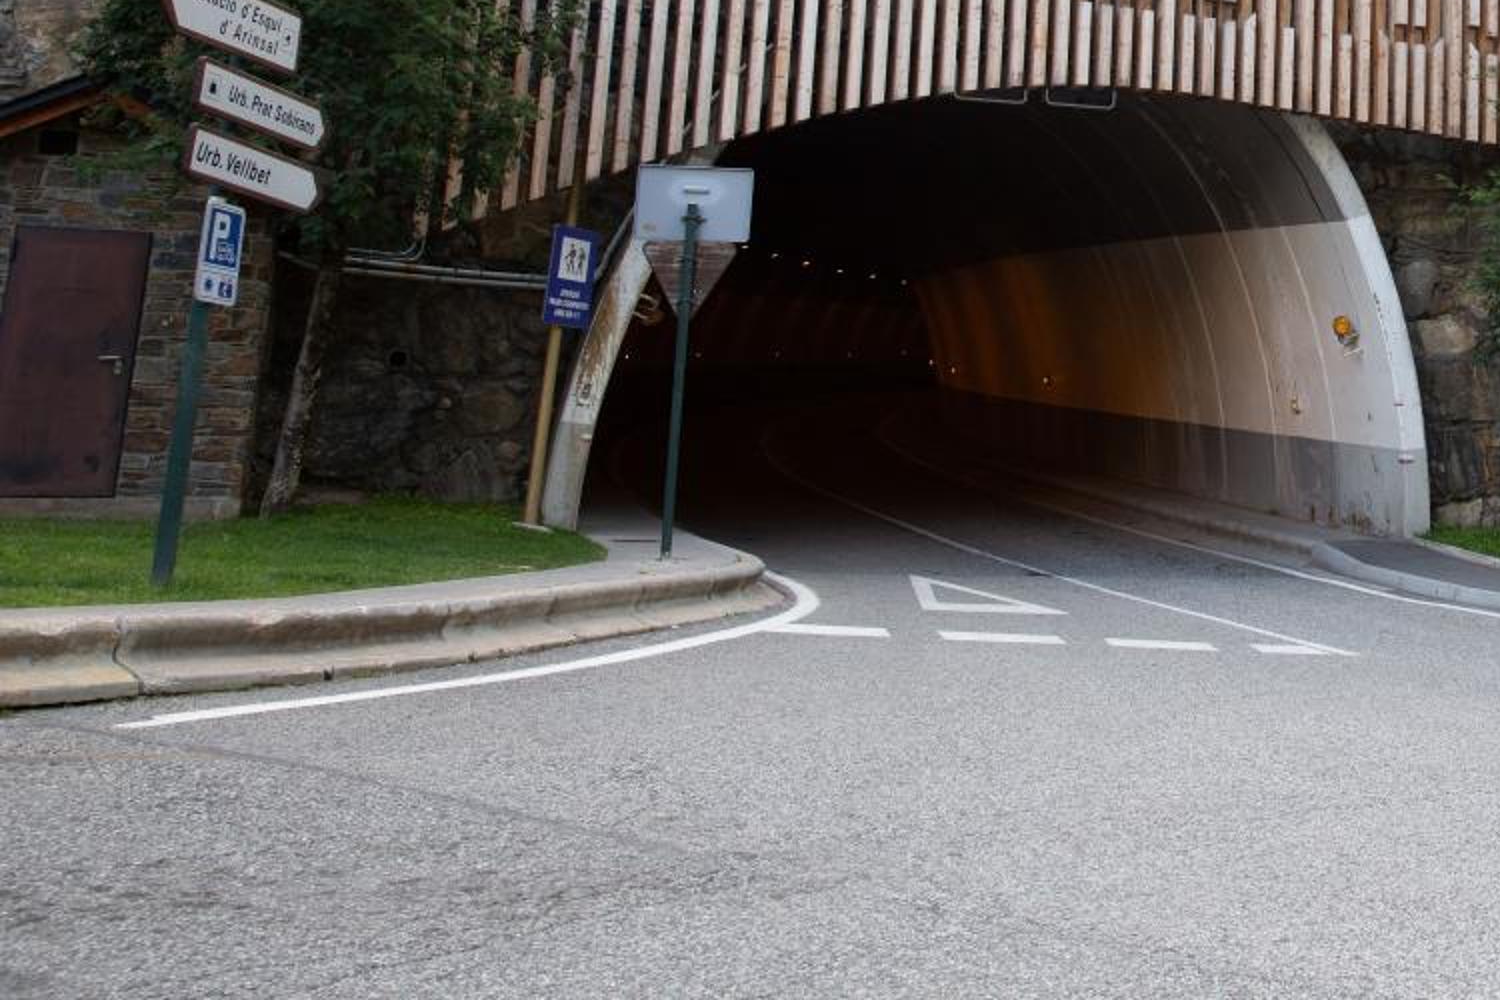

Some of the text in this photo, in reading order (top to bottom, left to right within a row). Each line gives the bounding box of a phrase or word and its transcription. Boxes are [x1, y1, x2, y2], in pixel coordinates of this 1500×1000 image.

[229, 85, 249, 109] Urb.
[251, 95, 273, 119] Prat
[196, 141, 272, 185] Urb. Vellbet
